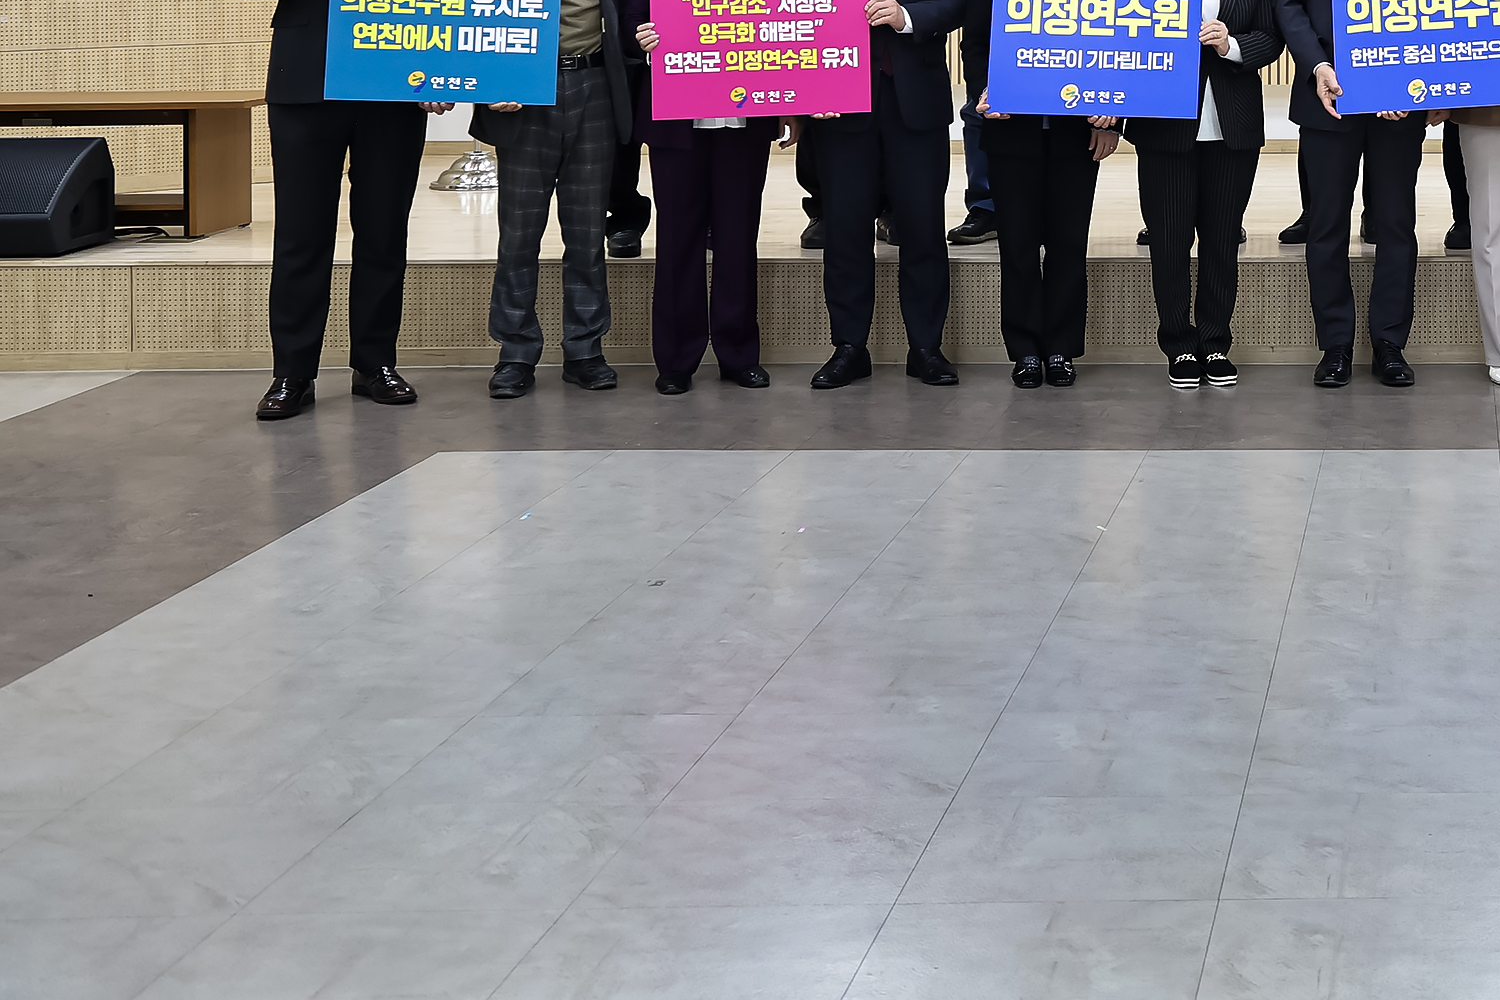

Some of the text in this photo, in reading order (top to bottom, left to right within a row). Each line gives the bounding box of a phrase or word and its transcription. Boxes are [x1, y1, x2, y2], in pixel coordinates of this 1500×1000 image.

[352, 22, 538, 54] 연천에서 미래로!
[698, 22, 756, 44] 양극화
[663, 47, 859, 74] 연천군 의정연수원 유치
[1016, 48, 1174, 71] 연천군이 기다립니다!
[1350, 46, 1400, 68] 한반도
[1403, 44, 1436, 65] 중심
[430, 76, 478, 90] 연천군
[1429, 82, 1472, 97] 연천군
[751, 90, 797, 104] 연천군
[1082, 90, 1125, 104] 연천군
